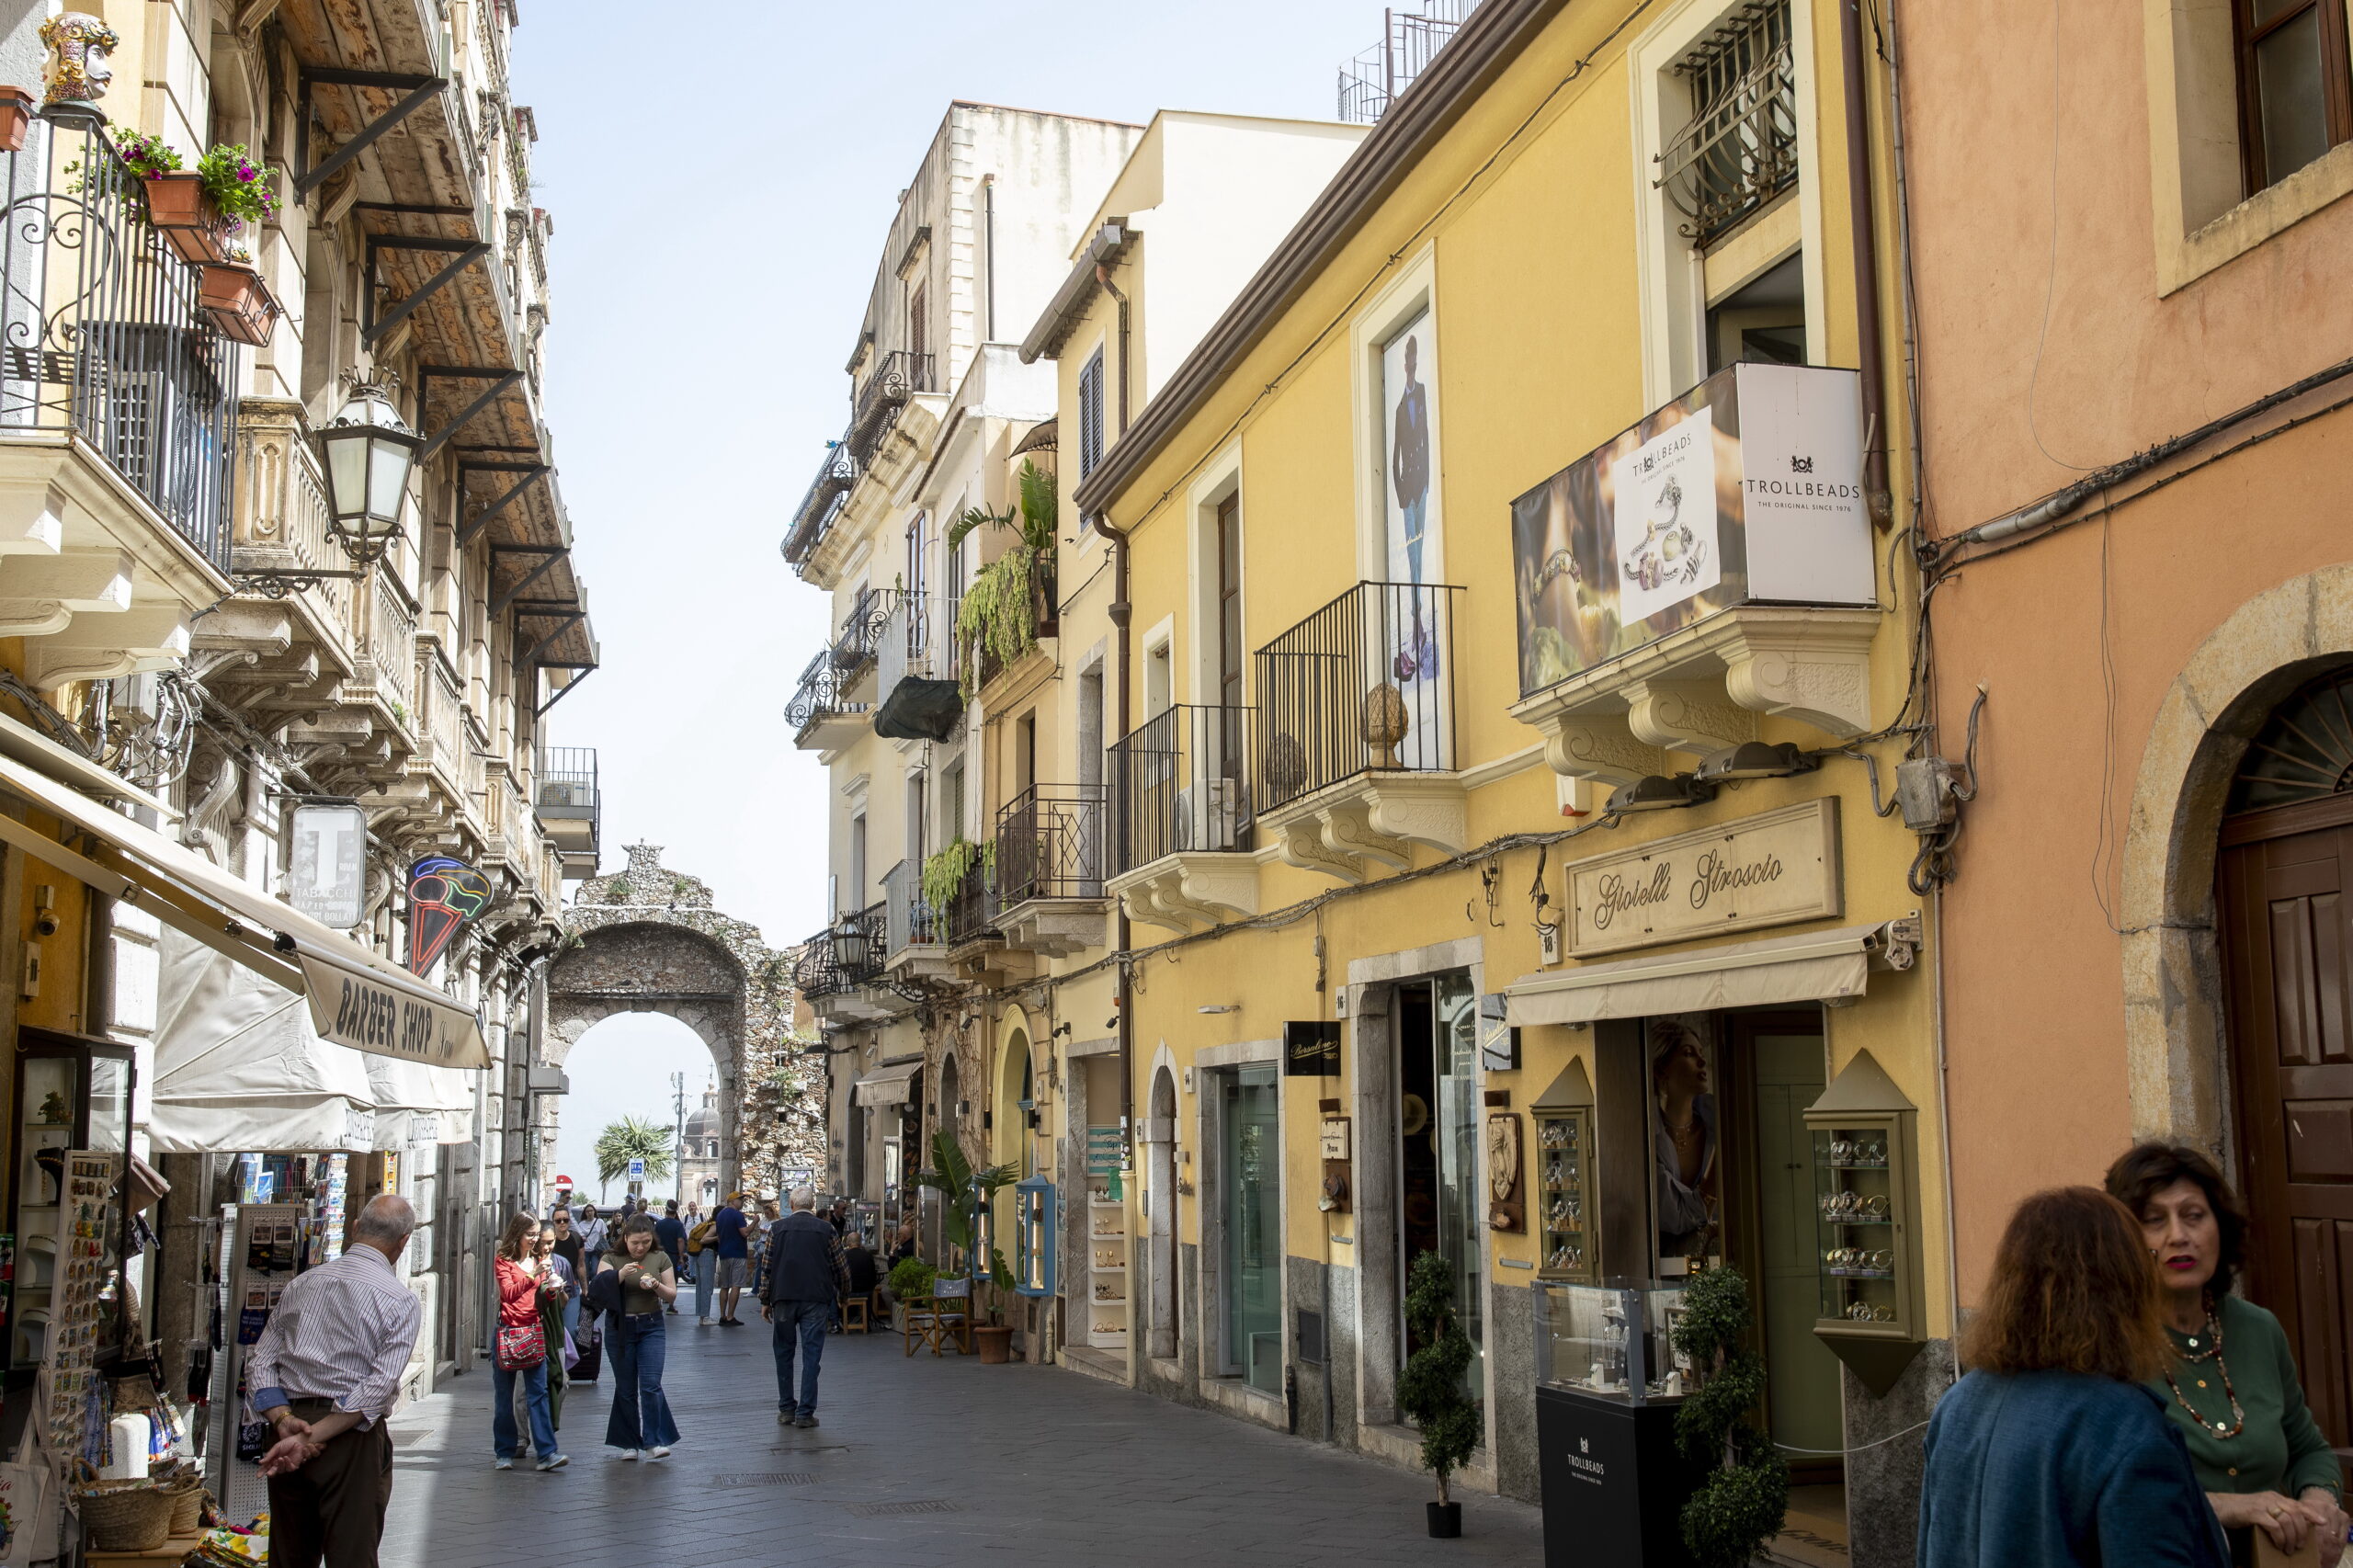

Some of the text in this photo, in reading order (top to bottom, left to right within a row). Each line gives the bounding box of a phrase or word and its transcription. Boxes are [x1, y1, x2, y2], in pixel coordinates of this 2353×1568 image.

[1746, 479, 1859, 499] TROLLBEADS
[1774, 502, 1809, 510] ORIGINAL
[295, 887, 357, 899] TABACCHI
[1594, 848, 1783, 930] Gioielli Stroscio
[1543, 936, 1553, 954] 18
[1336, 994, 1344, 1009] 16
[336, 977, 396, 1051] BARBER
[402, 1000, 433, 1055] SHOP
[1567, 1453, 1604, 1475] TROLLBEADS
